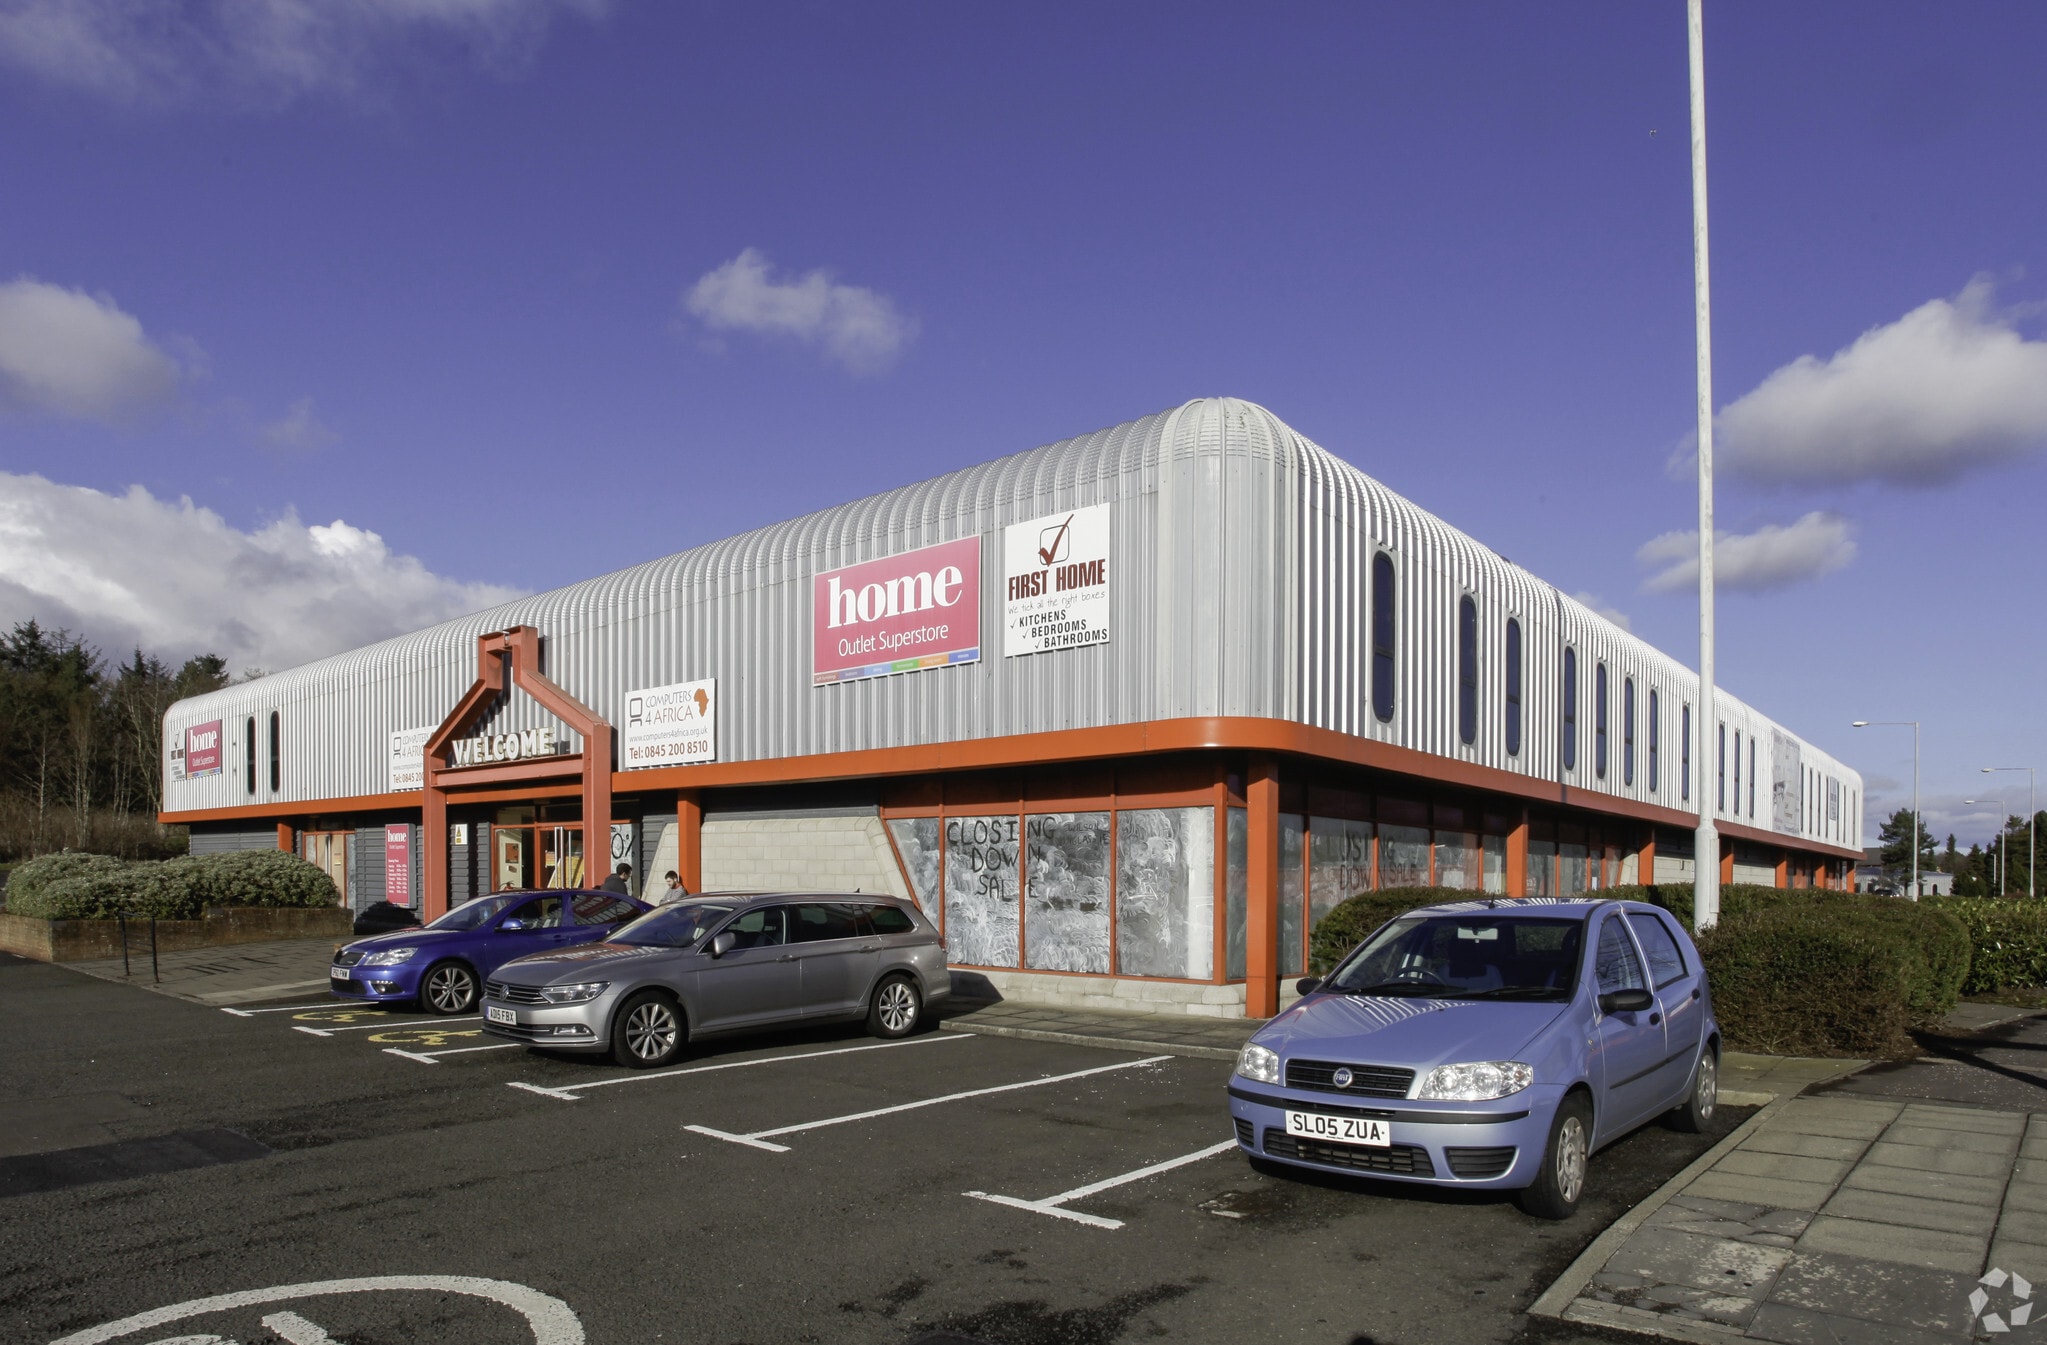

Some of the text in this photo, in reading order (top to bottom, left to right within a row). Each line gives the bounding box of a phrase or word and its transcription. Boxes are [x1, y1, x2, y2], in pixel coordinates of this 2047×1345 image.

[1008, 558, 1106, 602] FIRST HOME
[827, 566, 963, 629] home
[1008, 606, 1019, 615] We
[1022, 601, 1034, 612] tick
[1047, 597, 1058, 608] the
[1061, 593, 1078, 609] right
[1081, 590, 1106, 602] boxes
[1019, 609, 1067, 628] KITCHENS
[1031, 619, 1087, 638] BEDROOMS
[838, 624, 949, 657] Outlet Superstore
[1044, 628, 1108, 648] BATHROOMS
[645, 689, 692, 709] COMPUTERS
[645, 704, 694, 725] 4 AFRICA
[190, 729, 218, 753] home
[452, 727, 556, 764] WELCOME
[629, 724, 708, 743] www.computers4africa.org.uk
[629, 739, 708, 760] Tel: 0845 200 8510
[387, 829, 407, 843] home
[946, 816, 1057, 847] CLOSING
[971, 843, 1041, 873] DOWN
[974, 874, 1039, 902] SALE
[501, 1010, 515, 1022] FBX
[1293, 1113, 1381, 1141] SL05 ZUA
